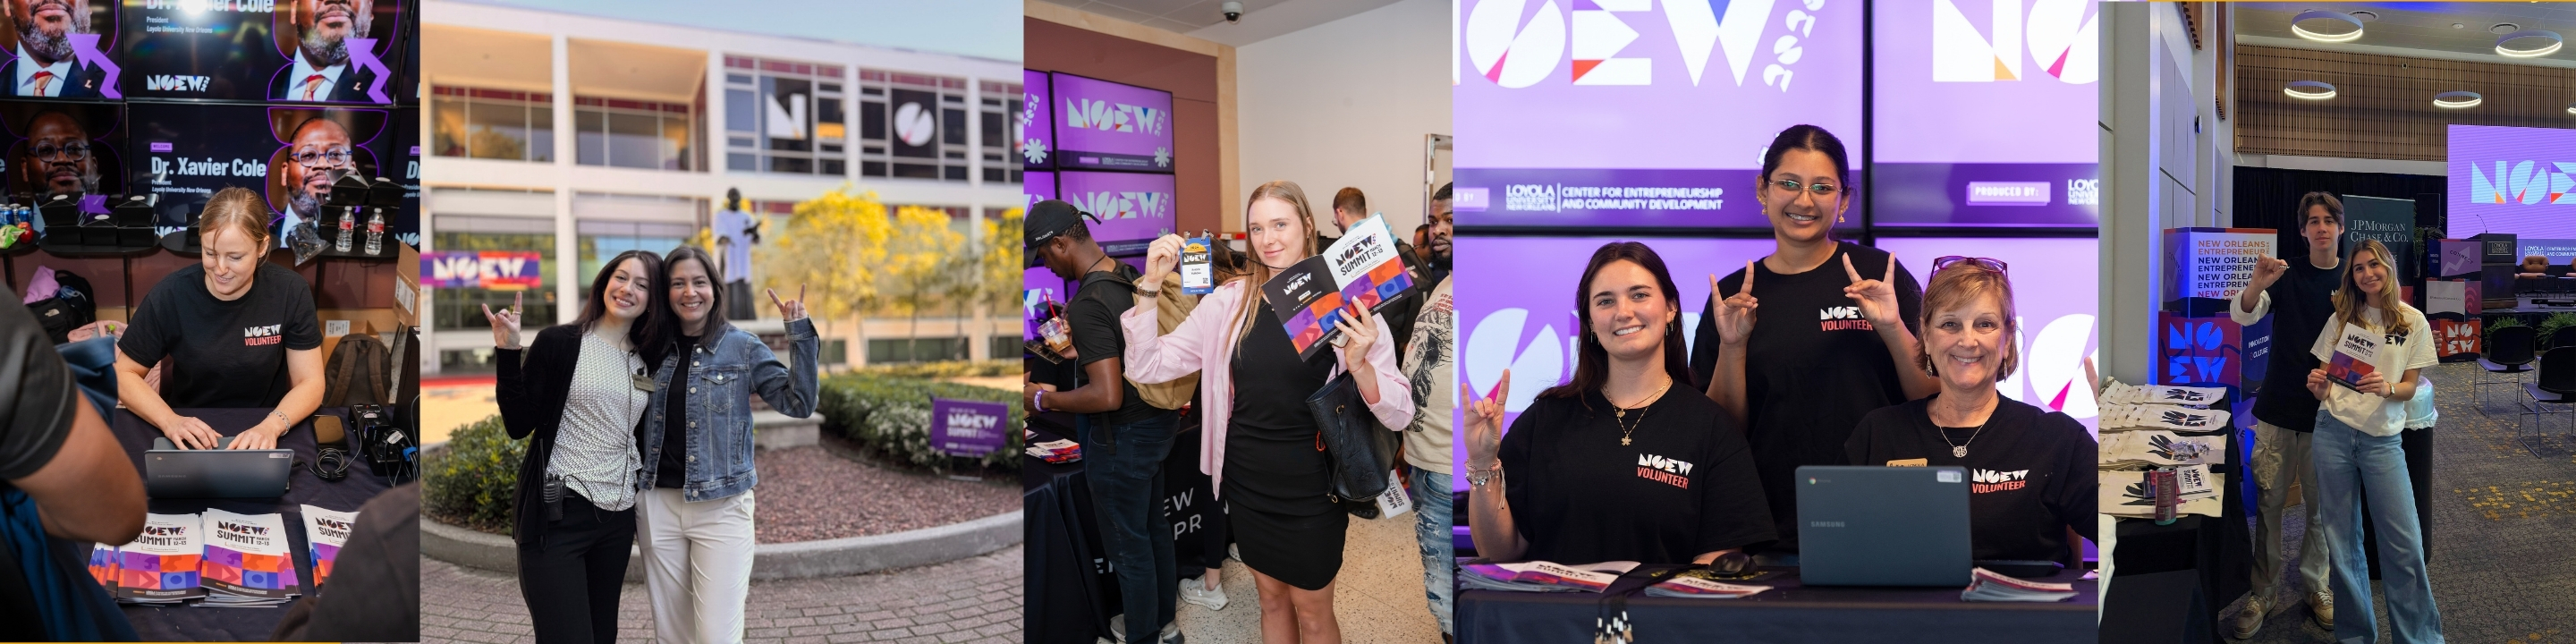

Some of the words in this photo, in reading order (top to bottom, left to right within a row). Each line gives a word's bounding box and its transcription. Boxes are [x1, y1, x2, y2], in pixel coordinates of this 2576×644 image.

[236, 0, 275, 13] Cole
[162, 26, 184, 34] University
[1453, 0, 1776, 88] OEW
[147, 74, 204, 91] NOEW
[1066, 96, 1157, 135] NOEW
[151, 157, 174, 174] Dr.
[177, 157, 230, 176] Xavier
[232, 158, 267, 177] Cole
[1505, 184, 1556, 197] LOYOLA
[1562, 187, 1602, 198] CENTER
[1603, 187, 1623, 198] FOR
[1624, 187, 1724, 199] ENTREPRENEURSHIP
[1975, 186, 2021, 196] PRODUCED
[1562, 199, 1585, 209] AND
[1585, 199, 1648, 210] COMMUNITY
[1648, 199, 1724, 210] DEVELOPMENT
[2198, 240, 2221, 248] NEW
[2224, 240, 2266, 248] ORLEANS
[2384, 233, 2393, 242] &
[1335, 234, 1373, 267] NOEW
[2198, 248, 2266, 256] ENTREPRENEUR
[2449, 250, 2474, 265] CONNECT
[433, 257, 526, 280] NOEW
[1340, 250, 1371, 276] SUMMIT
[2198, 265, 2256, 273] ENTREPRENE
[1283, 272, 1312, 296] NOEW
[2198, 273, 2221, 281] NEW
[2223, 273, 2253, 281] ORLEA
[2198, 281, 2250, 289] ENTREPREN
[1820, 306, 1865, 320] NOE
[244, 323, 282, 337] NOEW
[1820, 319, 1874, 332] VOLUNTEER
[244, 335, 282, 346] VOLUNTEER
[2248, 335, 2270, 348] INNOVATION
[2343, 340, 2367, 354] SUMMIT
[2347, 333, 2375, 349] NOEW
[2252, 346, 2268, 359] CULTURE
[1638, 453, 1693, 476] NOEW
[1637, 466, 1690, 489] VOLUNTEER
[1972, 468, 2029, 483] NOEW
[1971, 479, 2027, 494] VOLUNTEER
[1390, 486, 1405, 507] SUMMIT
[141, 526, 182, 536] OEW
[217, 520, 266, 536] NOEW
[318, 526, 352, 540] SUMMI
[216, 530, 256, 545] SUMMIT
